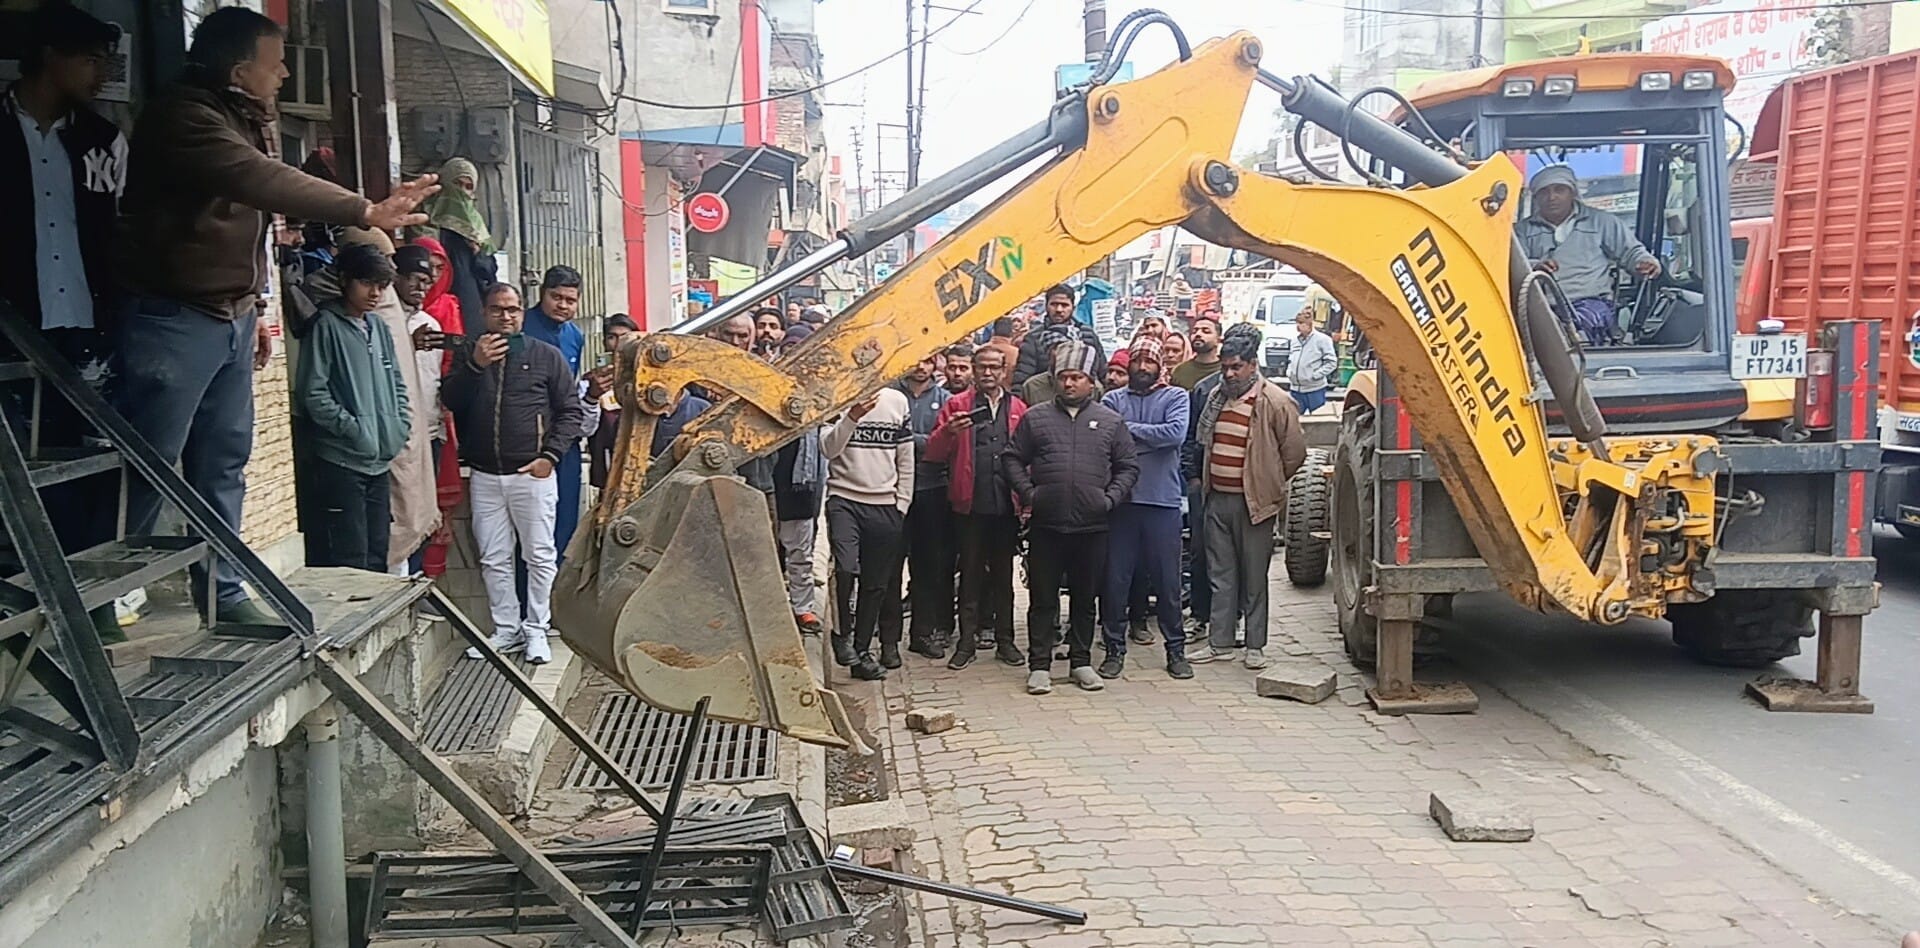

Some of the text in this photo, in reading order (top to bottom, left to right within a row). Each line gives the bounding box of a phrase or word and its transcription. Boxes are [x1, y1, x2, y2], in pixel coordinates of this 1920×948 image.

[1751, 338, 1798, 356] UP 15
[1746, 357, 1803, 375] FT7341
[852, 429, 897, 442] RSACE
